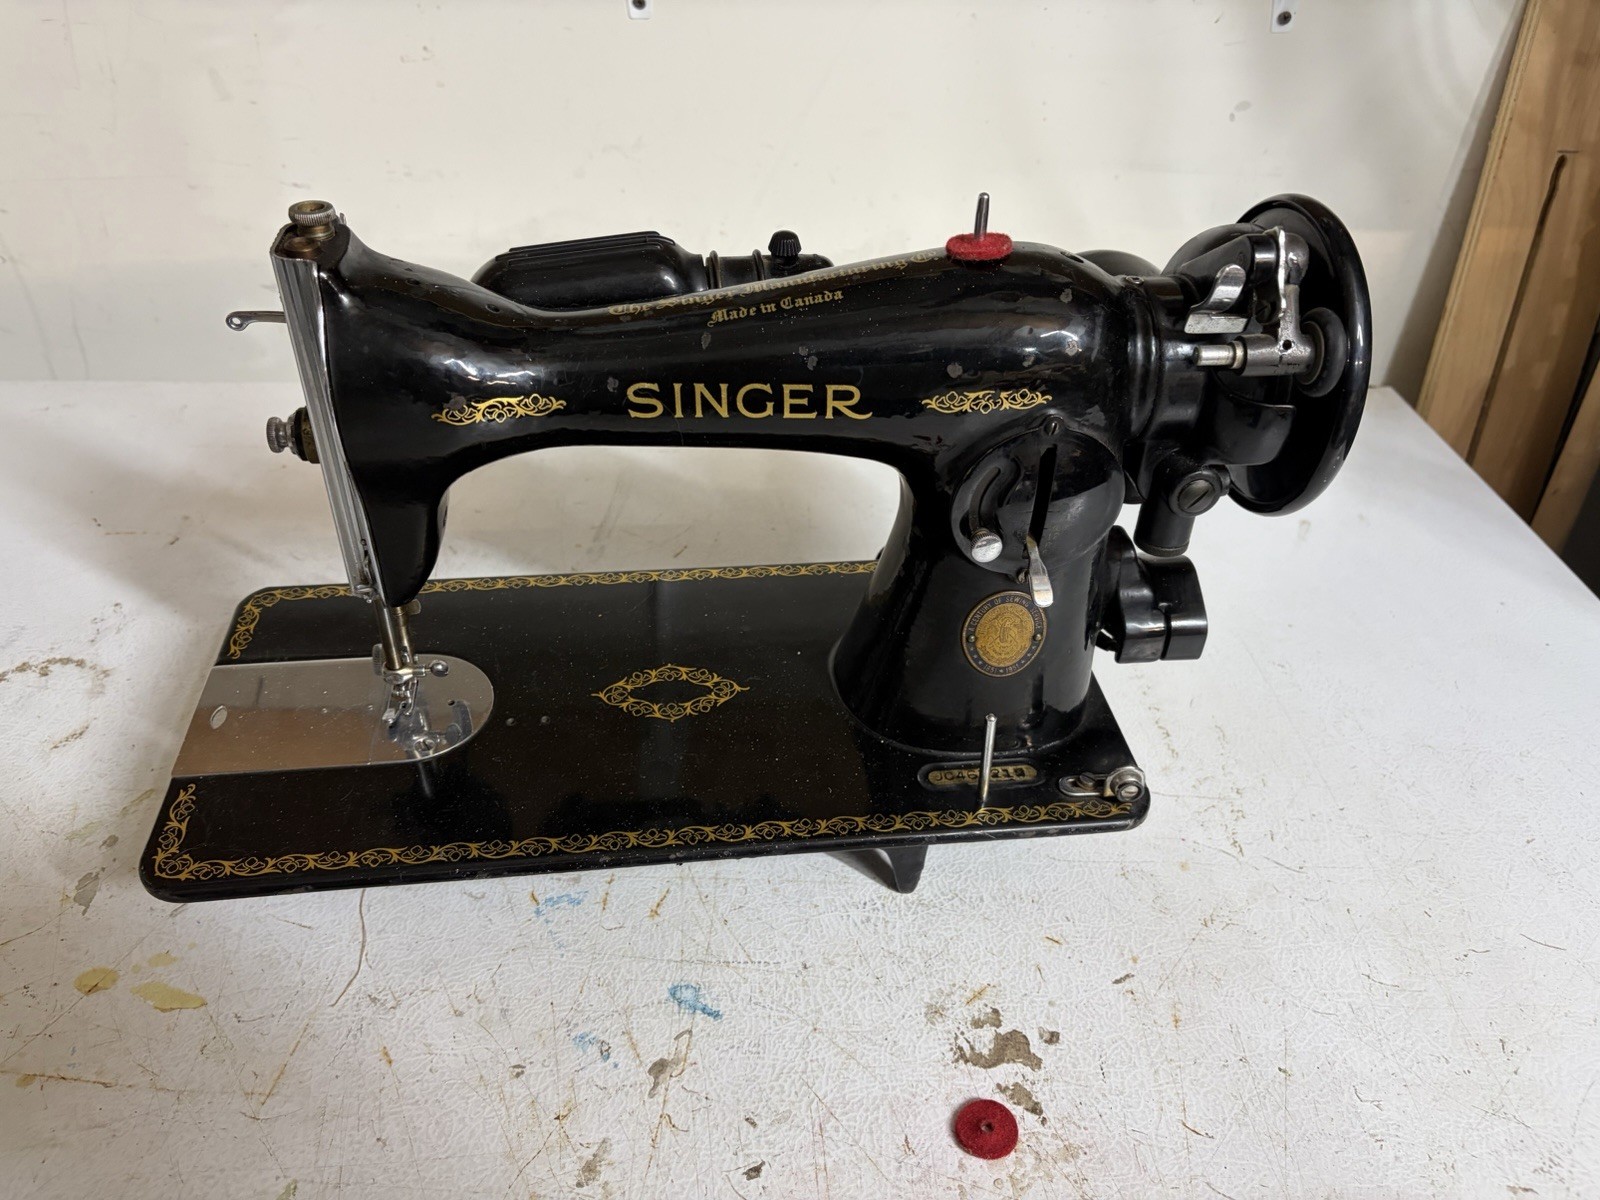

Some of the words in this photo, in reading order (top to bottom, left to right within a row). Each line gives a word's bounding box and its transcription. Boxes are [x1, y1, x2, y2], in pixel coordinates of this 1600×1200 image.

[608, 303, 653, 316] The
[656, 289, 733, 309] Singer
[707, 307, 757, 328] Made
[759, 302, 777, 314] in
[780, 289, 844, 309] Canada
[626, 381, 874, 420] SINGER
[972, 603, 991, 626] CENTURY
[1005, 595, 1029, 607] SEWING
[1030, 607, 1043, 629] SERVICE
[983, 664, 997, 674] 1851
[1005, 663, 1020, 674] 1951
